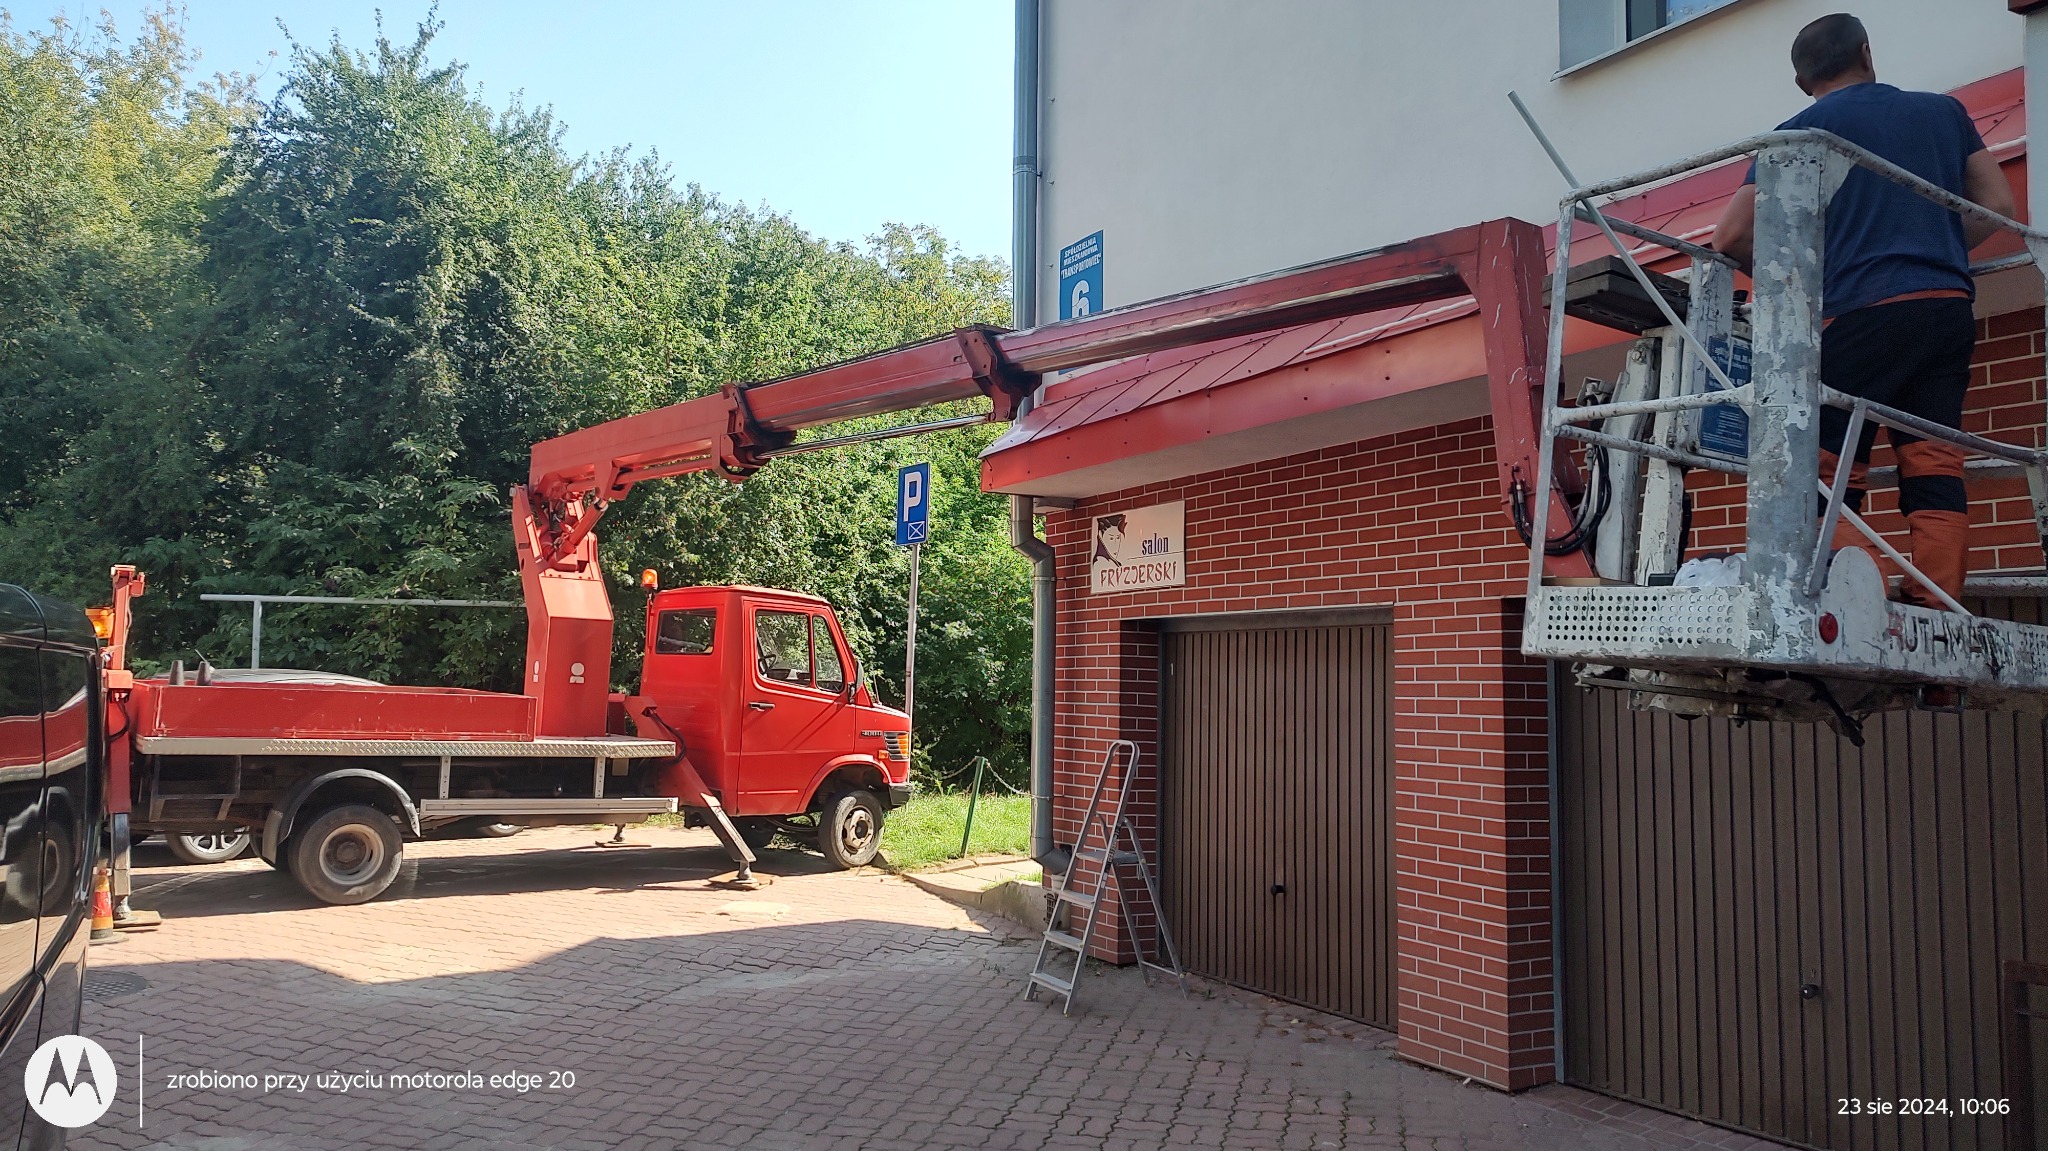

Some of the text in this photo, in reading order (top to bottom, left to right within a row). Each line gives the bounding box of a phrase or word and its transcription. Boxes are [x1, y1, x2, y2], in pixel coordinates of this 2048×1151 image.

[1072, 280, 1089, 318] 6
[903, 471, 922, 522] P
[1141, 532, 1169, 556] salon
[1100, 561, 1177, 588] FRYZJERSKI
